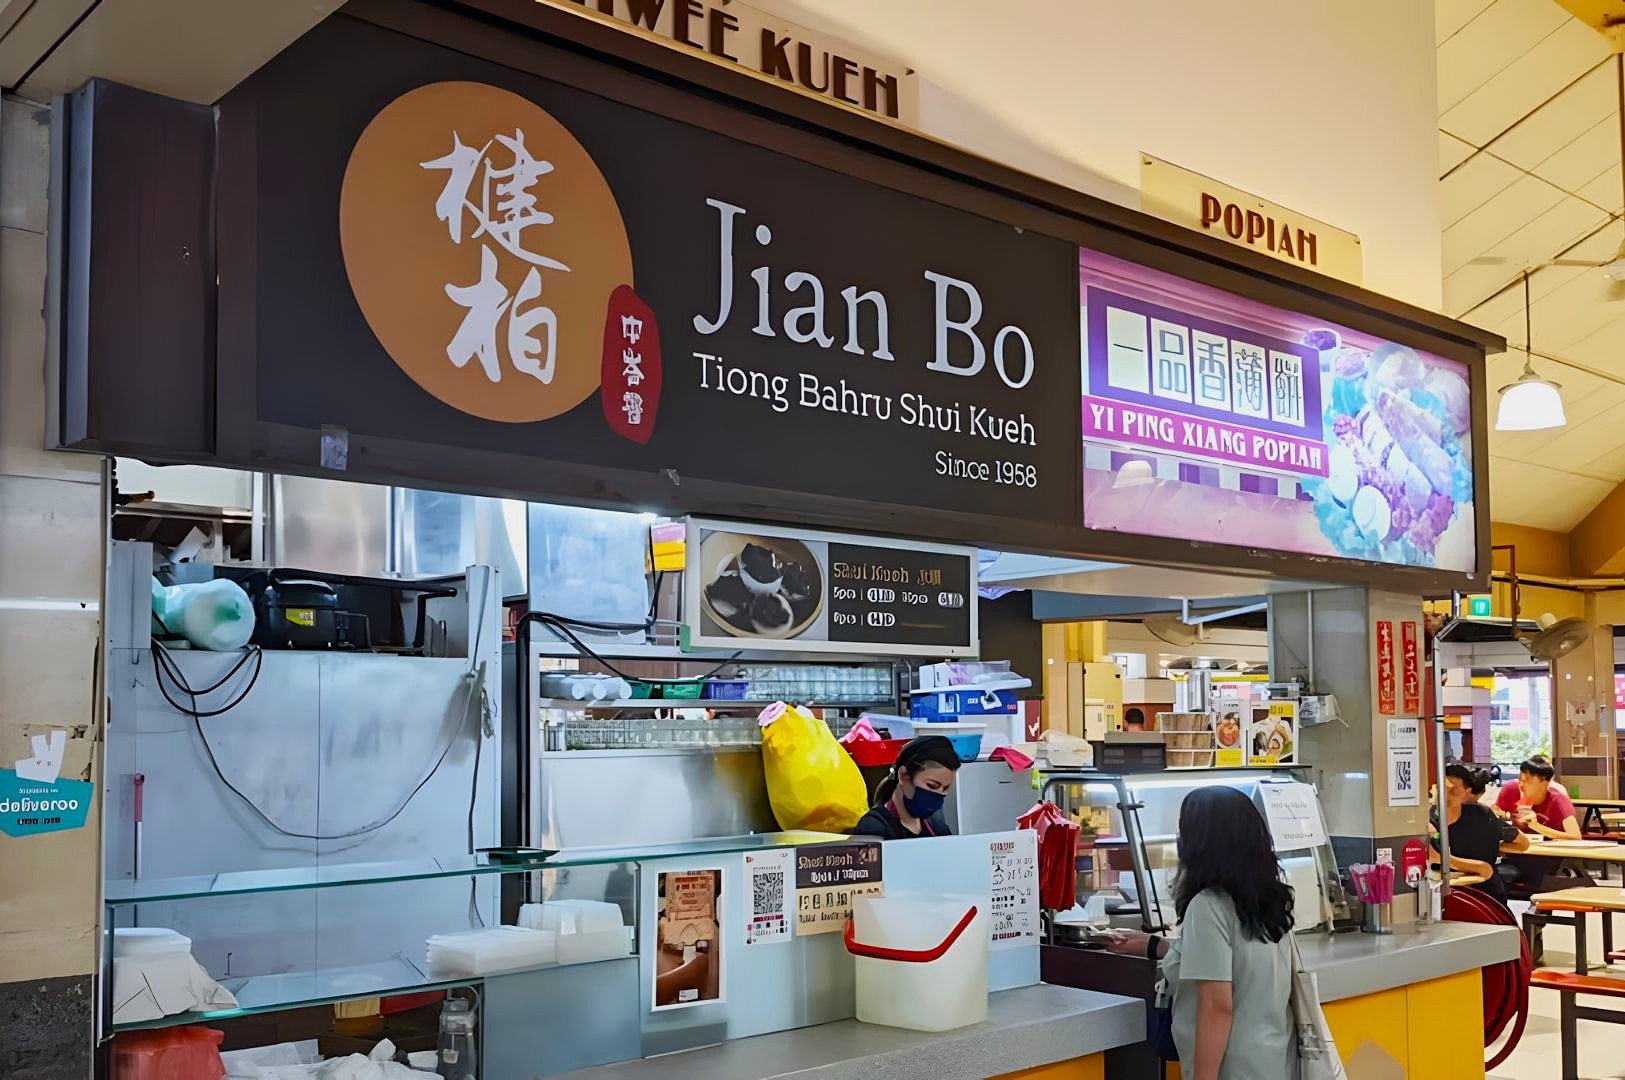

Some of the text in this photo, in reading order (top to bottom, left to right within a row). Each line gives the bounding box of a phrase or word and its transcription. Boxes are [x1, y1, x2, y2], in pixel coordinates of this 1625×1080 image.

[761, 28, 899, 119] KUEH
[1201, 192, 1317, 265] POPIAH
[692, 197, 1035, 389] Jian Bo
[692, 352, 1036, 445] Tiong Bahru Shui Kueh
[1089, 403, 1322, 470] YI PING XIANG POPIAH
[935, 451, 1037, 487] Since 1958
